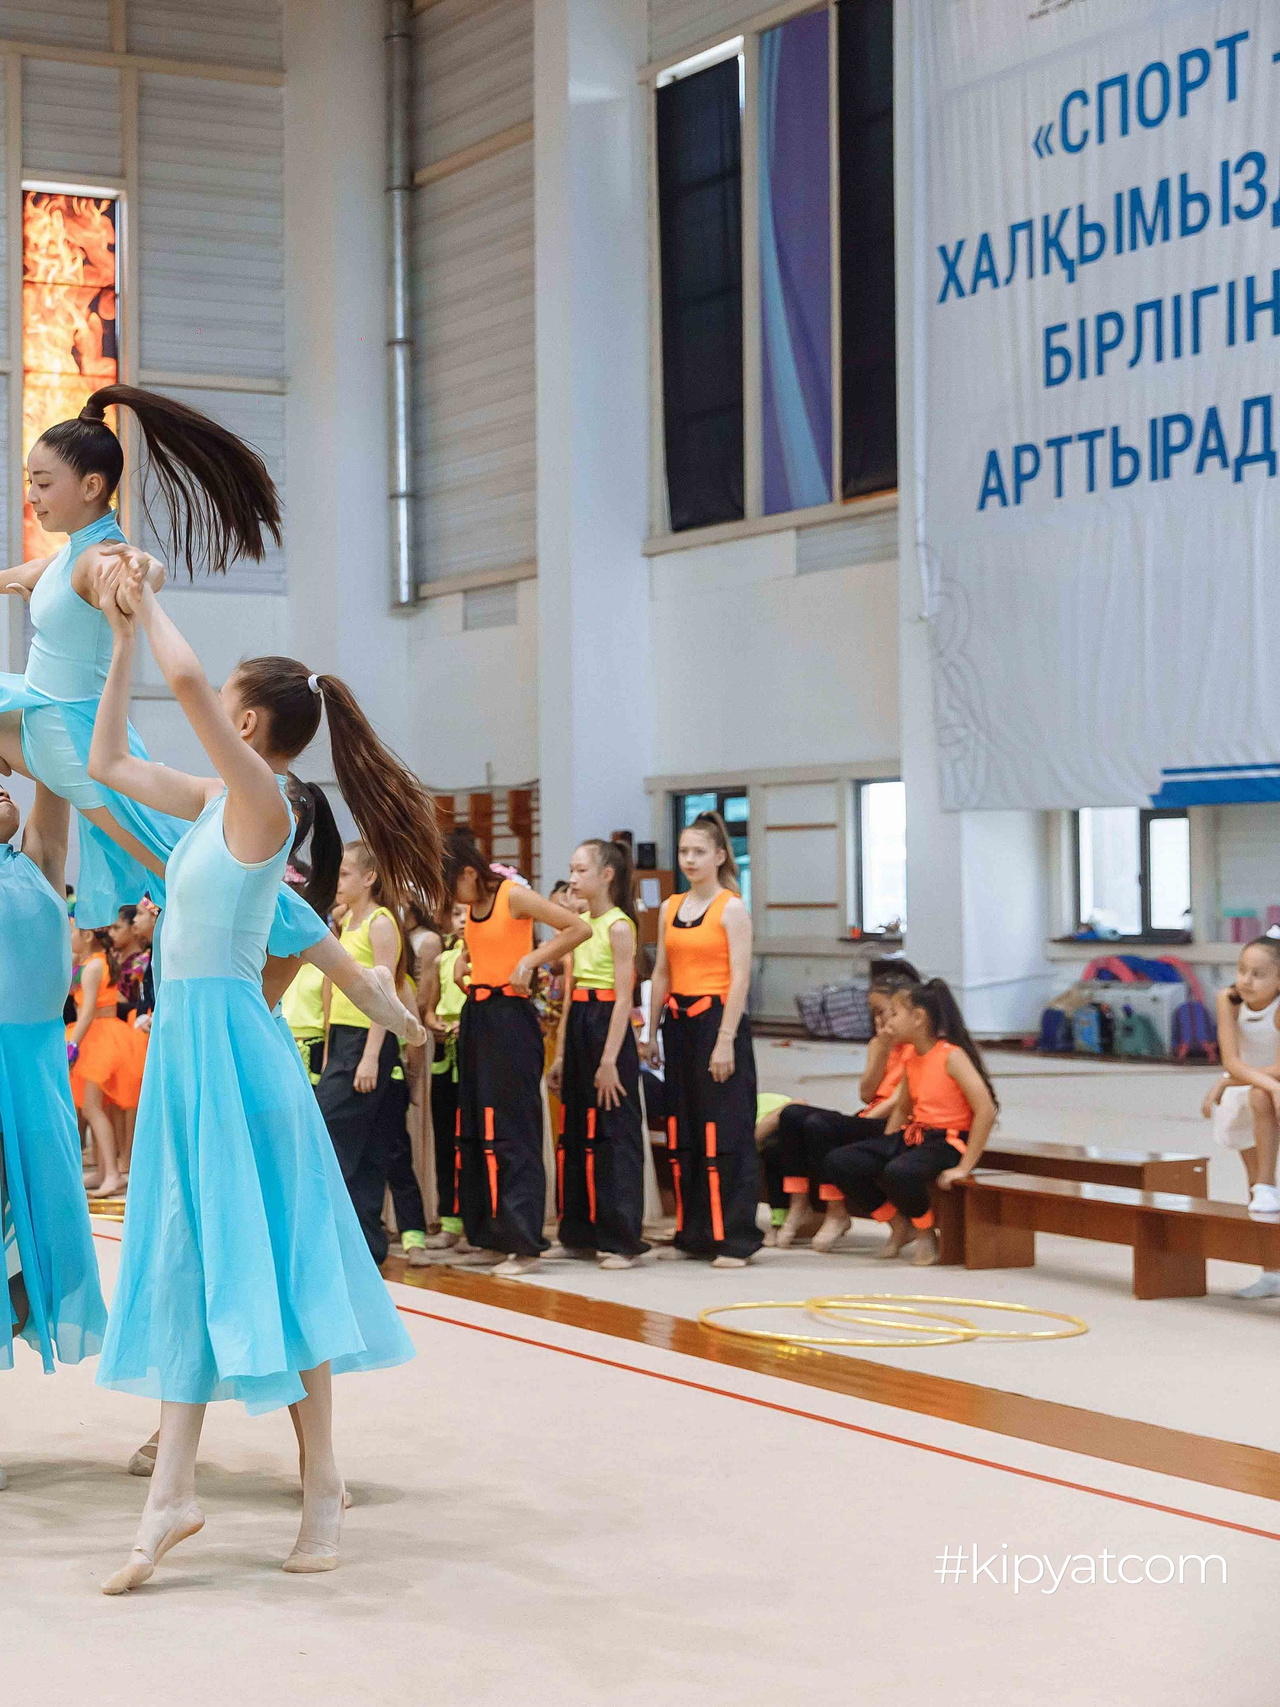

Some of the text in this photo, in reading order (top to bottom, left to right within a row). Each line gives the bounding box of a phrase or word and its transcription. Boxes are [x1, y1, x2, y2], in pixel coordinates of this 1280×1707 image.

[1032, 30, 1250, 159] «СПОРТ
[936, 151, 1280, 305] ХАЛҚЫМЫЗ
[977, 394, 1278, 512] АРТТЫРАД
